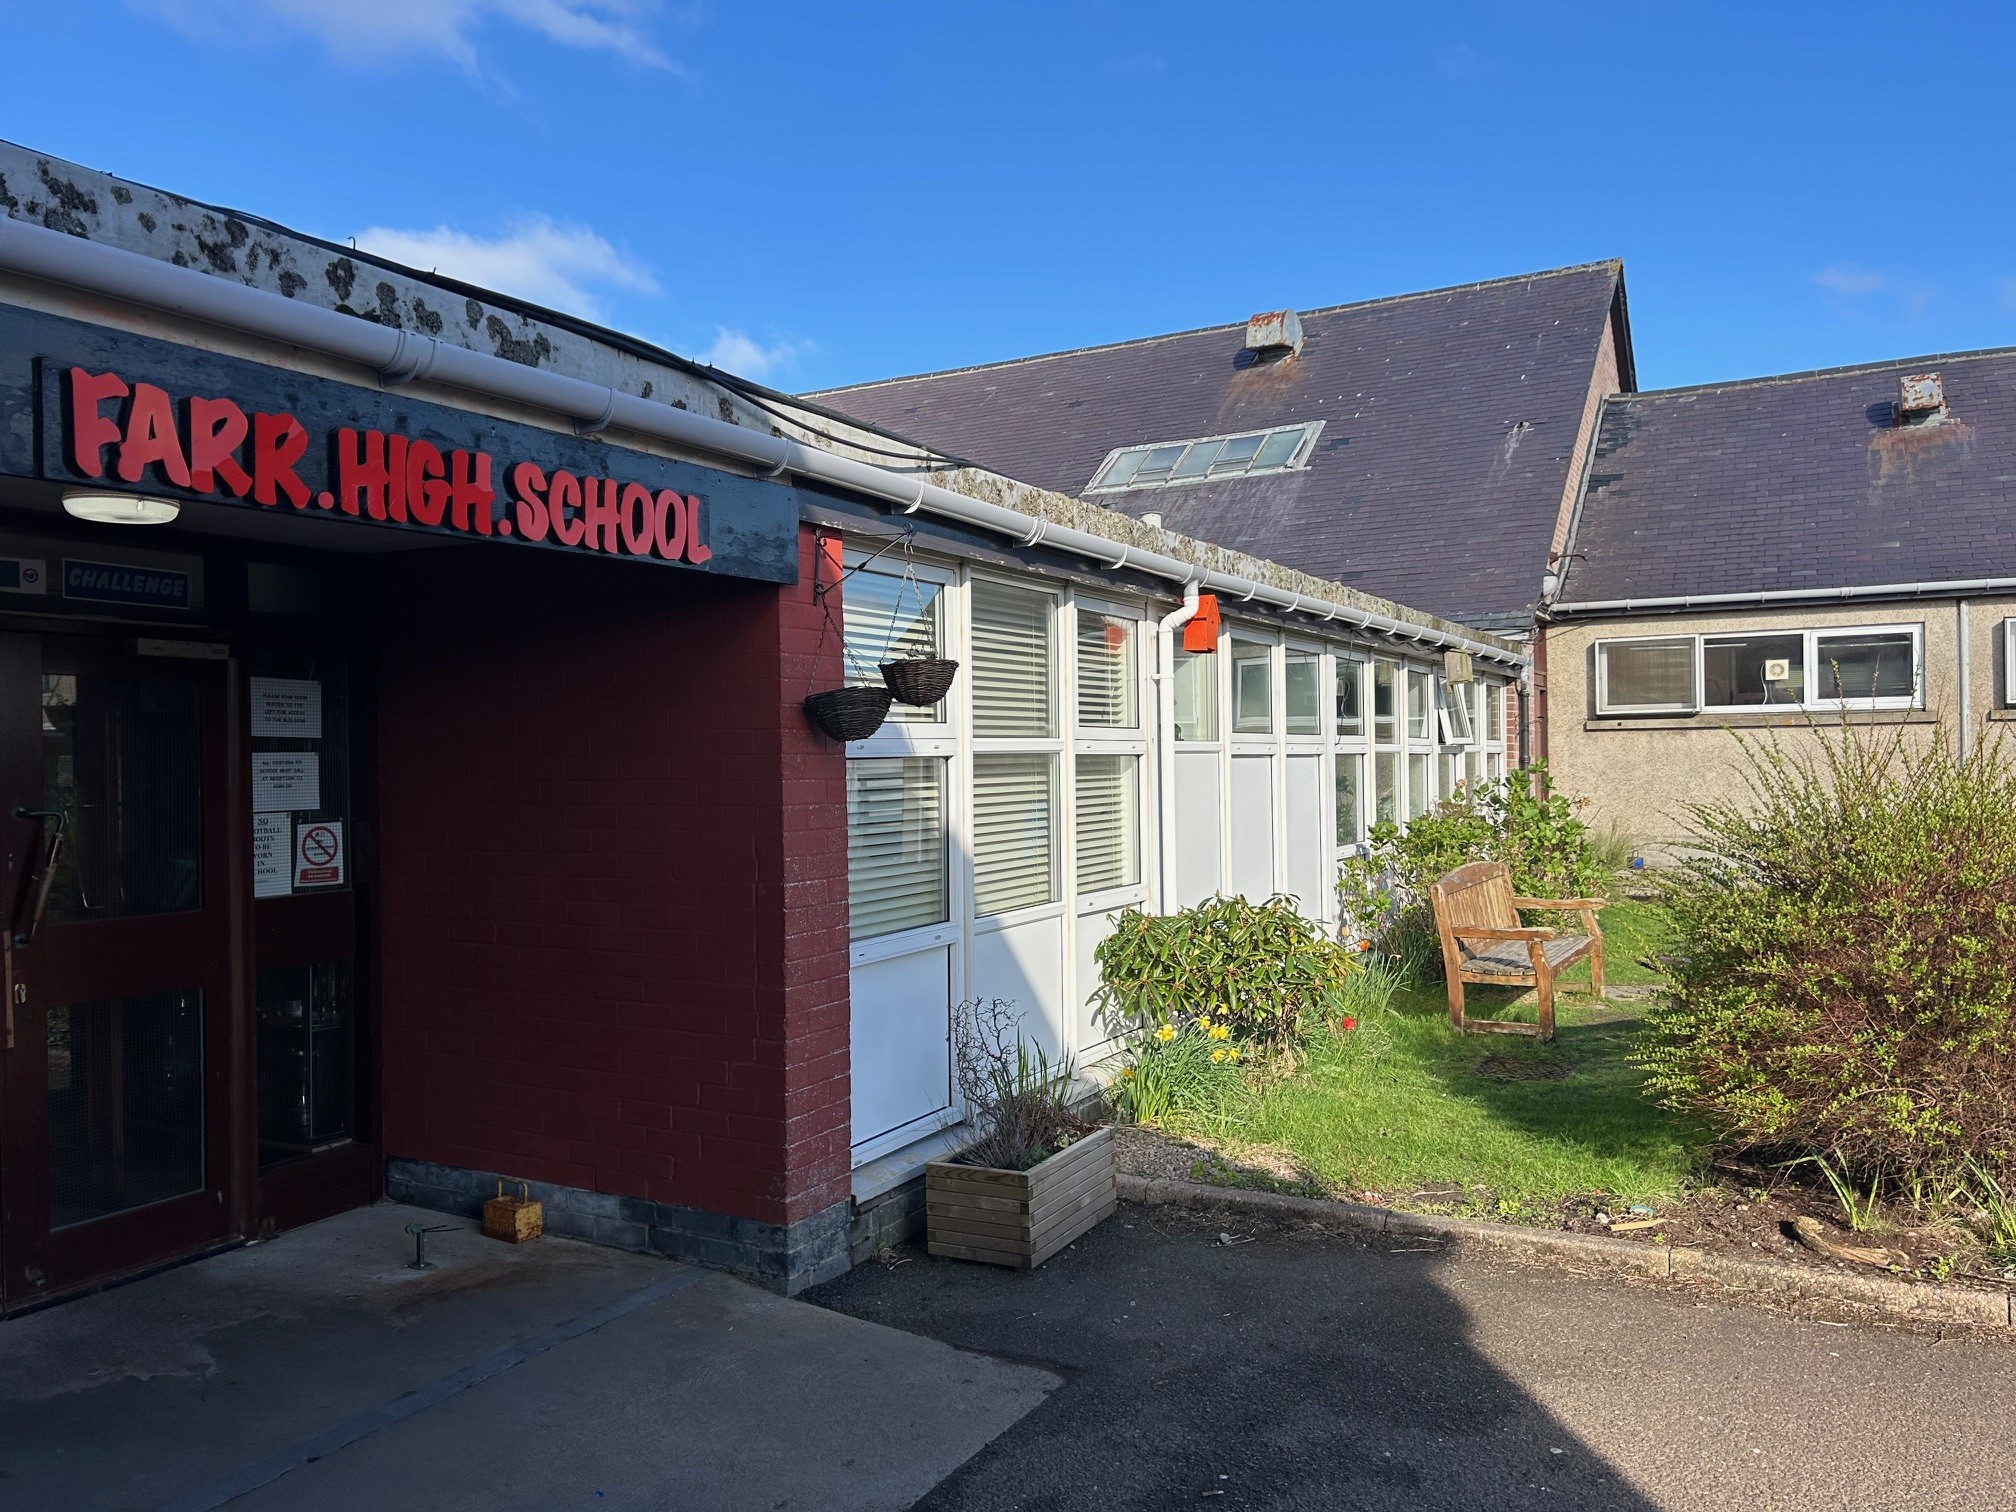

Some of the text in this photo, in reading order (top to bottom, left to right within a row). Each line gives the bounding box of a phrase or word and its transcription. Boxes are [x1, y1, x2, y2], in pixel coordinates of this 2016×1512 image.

[513, 461, 712, 565] SCHOOL
[68, 567, 186, 597] CHALLENGE
[253, 827, 282, 835] OTBALL
